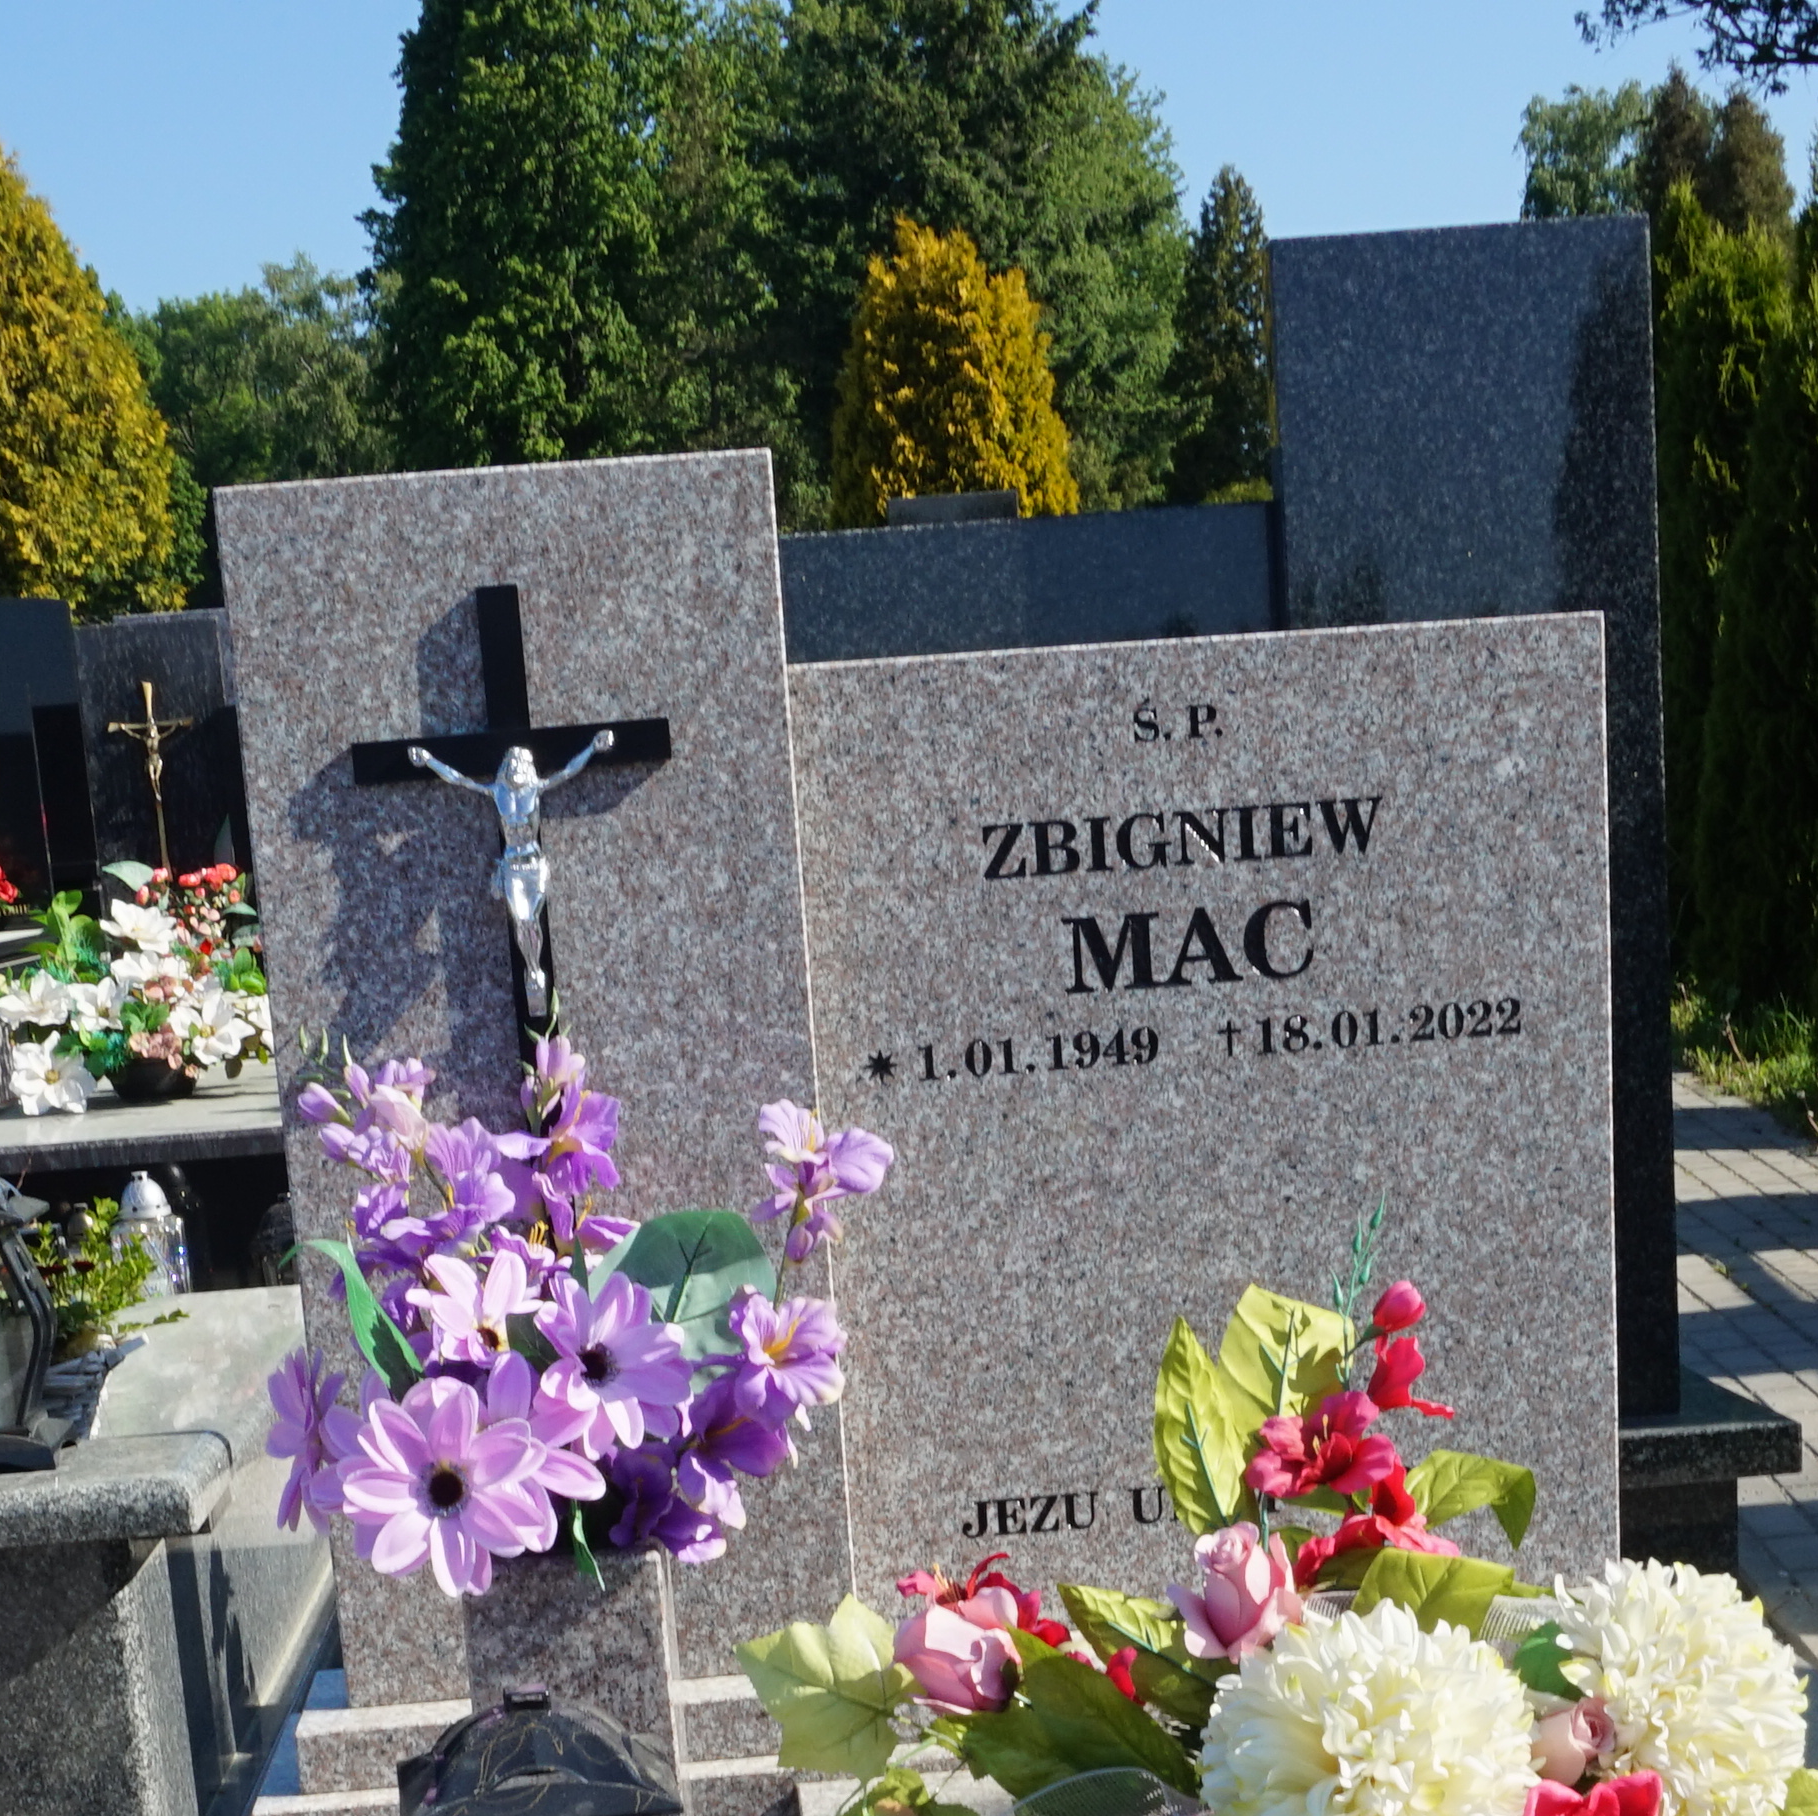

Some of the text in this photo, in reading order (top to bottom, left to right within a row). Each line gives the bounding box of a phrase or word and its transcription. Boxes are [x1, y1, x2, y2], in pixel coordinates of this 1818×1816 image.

[982, 797, 1382, 880] ZBIGNIEW
[1061, 899, 1314, 995] MAC
[962, 1491, 1099, 1539] JEZU
